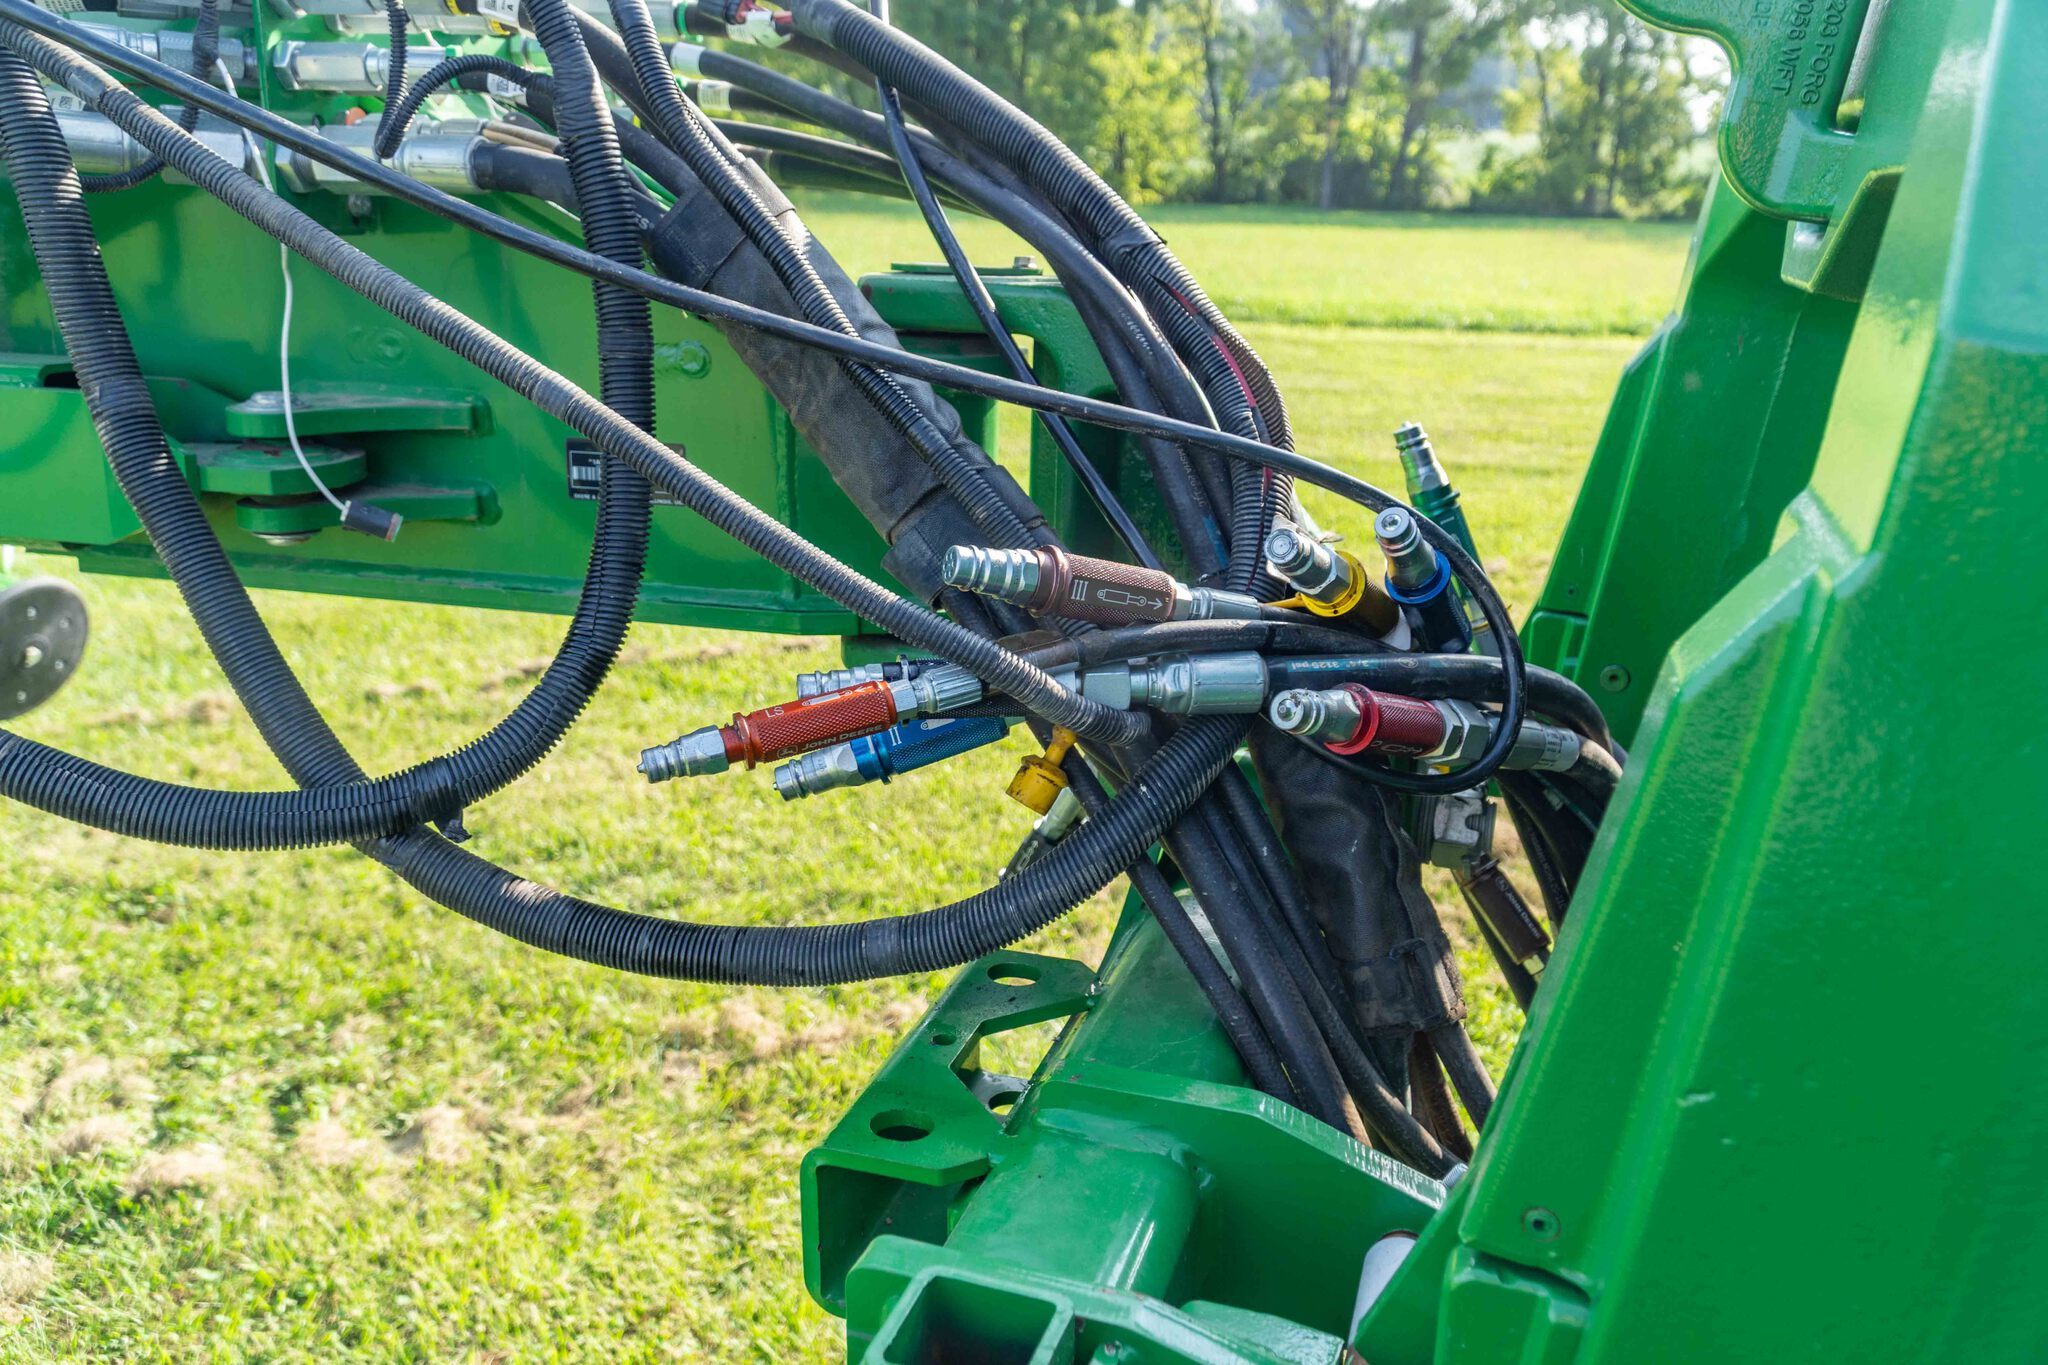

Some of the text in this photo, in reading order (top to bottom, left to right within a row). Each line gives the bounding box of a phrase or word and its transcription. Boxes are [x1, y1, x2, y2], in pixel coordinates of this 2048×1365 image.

[1800, 43, 1835, 105] FORG
[1070, 579, 1089, 601] III
[765, 706, 785, 718] LS
[801, 724, 884, 751] JOHN DEERE
[887, 726, 902, 747] II
